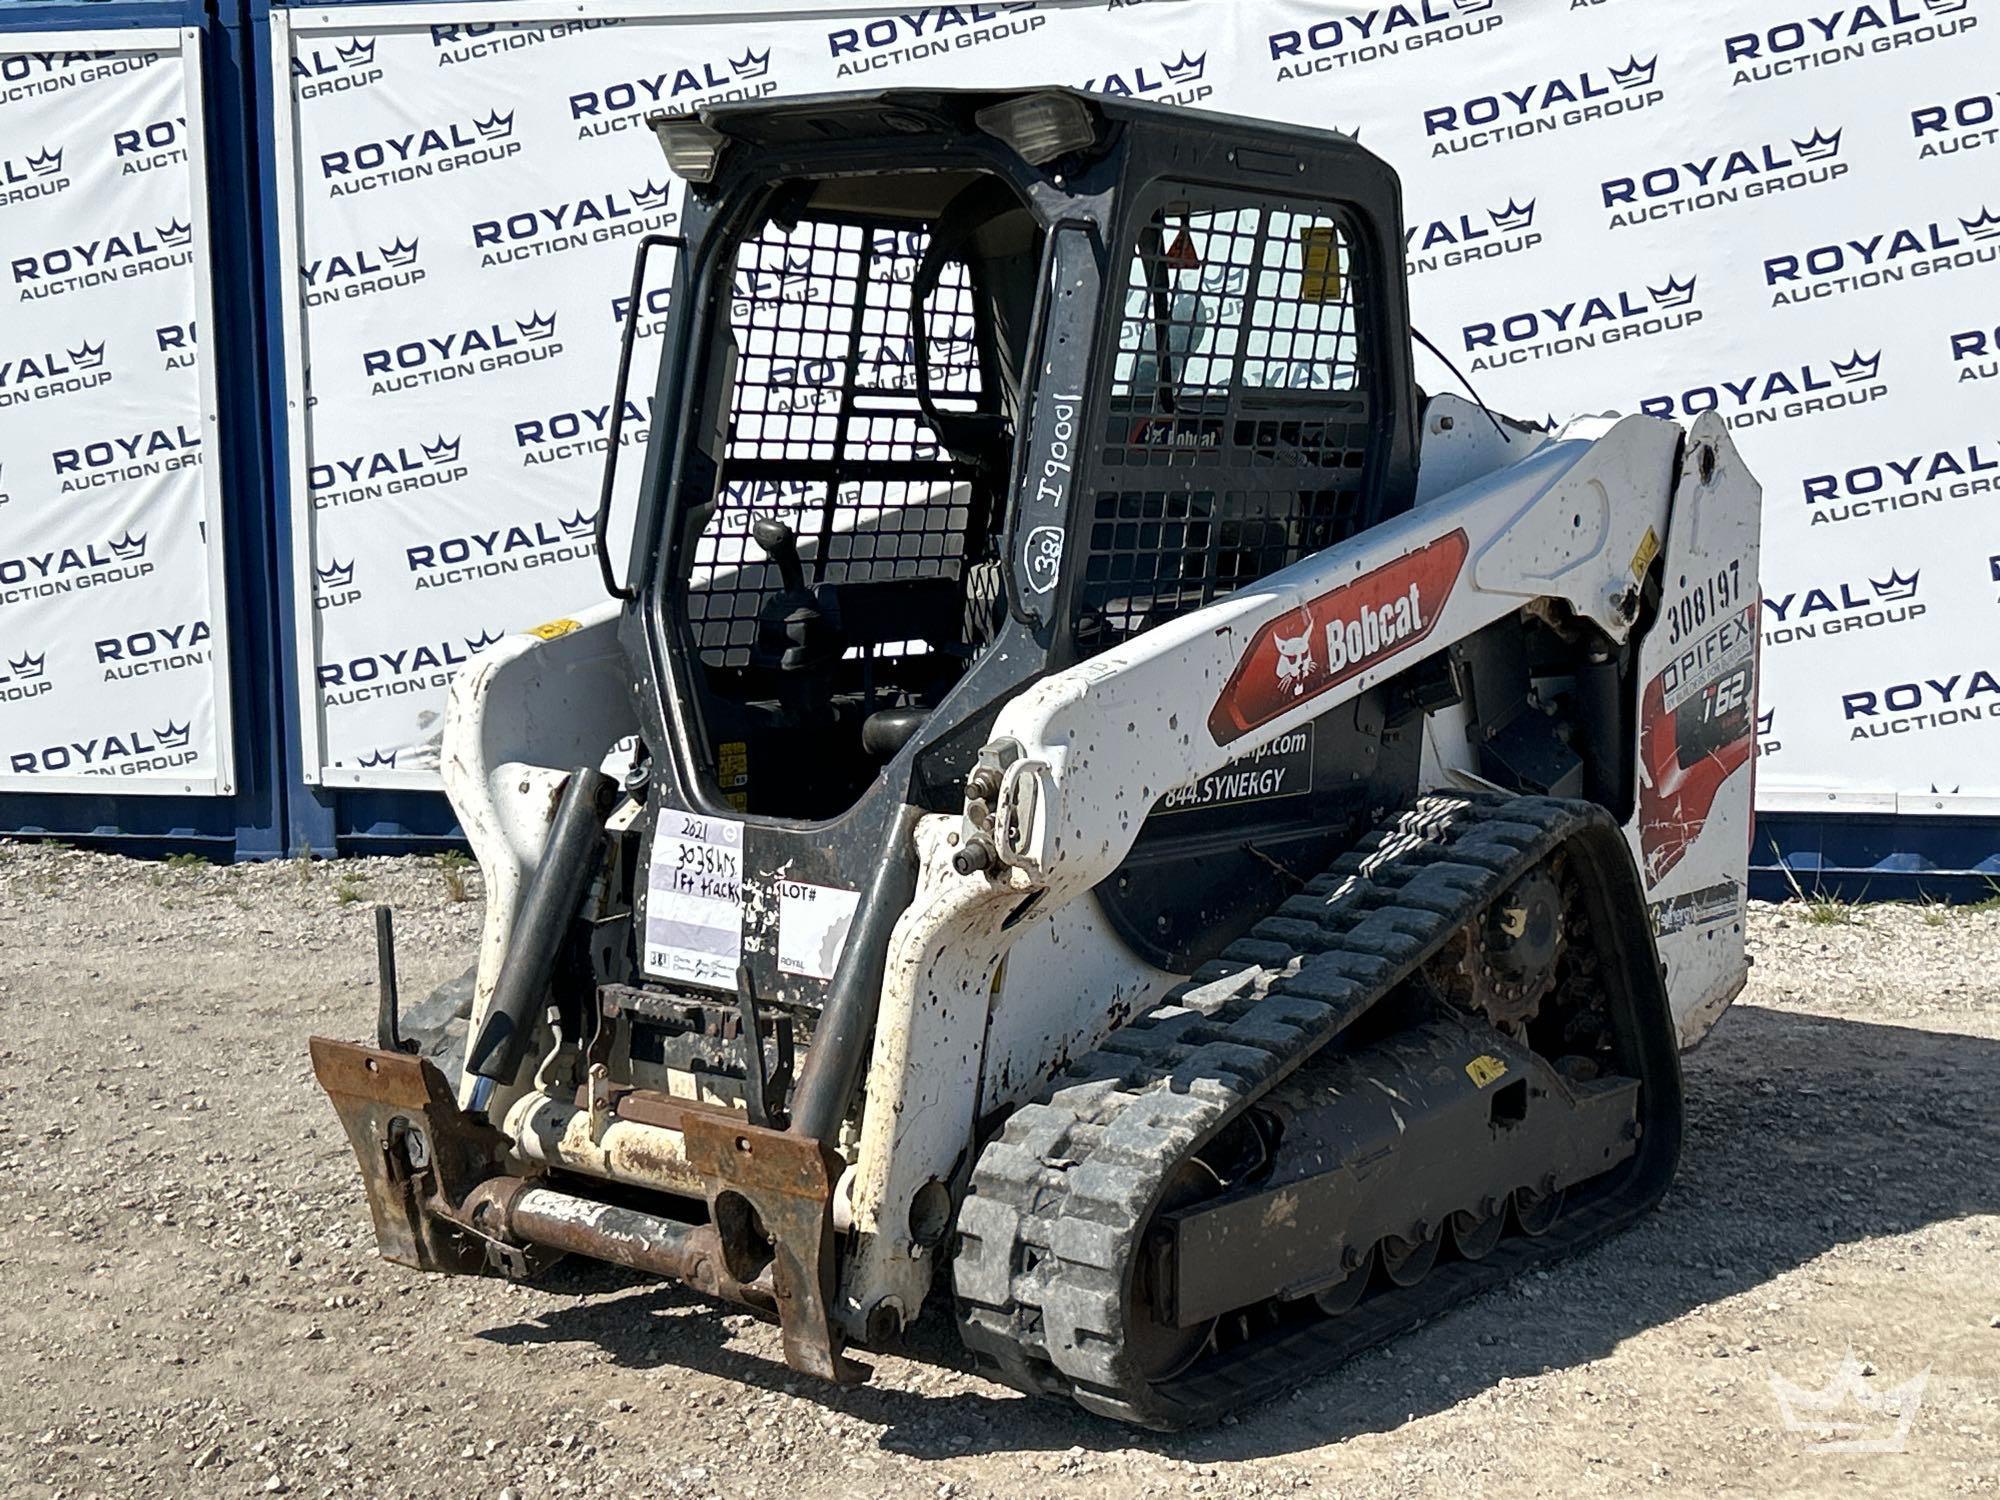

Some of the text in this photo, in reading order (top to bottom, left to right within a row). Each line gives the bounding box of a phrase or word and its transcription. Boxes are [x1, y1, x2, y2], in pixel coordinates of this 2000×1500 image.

[439, 29, 544, 67] AUCTION
[828, 5, 996, 58] ROYAL
[836, 15, 1046, 78] AUCTION GROUP
[1269, 0, 1449, 60] ROYAL
[1277, 15, 1503, 82] AUCTION GROUP
[1725, 0, 1919, 64] ROYAL
[1732, 16, 1977, 86] AUCTION GROUP
[81, 53, 158, 83] GROUP
[301, 69, 383, 99] GROUP
[569, 63, 730, 120] ROYAL
[1424, 72, 1609, 136] ROYAL
[1431, 91, 1664, 158] AUCTION GROUP
[321, 124, 475, 179] ROYAL
[330, 142, 521, 198] AUCTION GROUP
[1601, 144, 1792, 208] ROYAL
[472, 194, 631, 248] ROYAL
[1609, 163, 1848, 230] AUCTION GROUP
[11, 231, 158, 283] ROYAL
[481, 213, 677, 268] AUCTION GROUP
[1444, 233, 1542, 266] GROUP
[1764, 223, 1959, 286] ROYAL
[20, 268, 118, 302] AUCTION
[345, 269, 426, 298] GROUP
[1771, 266, 1903, 308] AUCTION
[1462, 291, 1648, 352] ROYAL
[1470, 310, 1703, 373] AUCTION GROUP
[363, 325, 518, 376] ROYAL
[372, 343, 563, 396] AUCTION GROUP
[35, 372, 112, 399] GROUP
[1640, 366, 1831, 420] ROYAL
[1784, 385, 1887, 418] GROUP
[52, 426, 201, 475] ROYAL
[1803, 445, 1998, 504] ROYAL
[62, 462, 160, 494] AUCTION
[388, 467, 468, 494] GROUP
[1811, 487, 1943, 525] AUCTION
[406, 522, 560, 570] ROYAL
[1034, 531, 1063, 576] 381
[76, 562, 153, 589] GROUP
[415, 559, 518, 590] AUCTION
[1667, 559, 1740, 645] 308197
[1823, 604, 1926, 635] GROUP
[1326, 582, 1422, 675] Bobcat
[1663, 612, 1748, 694] OPIFEX
[104, 652, 203, 682] AUCTION
[316, 642, 466, 689] ROYAL
[325, 678, 425, 708] AUCTION
[1850, 706, 1981, 741] AUCTION
[10, 732, 154, 773] ROYAL
[121, 751, 198, 776] GROUP
[1165, 768, 1286, 807] 844.SYNERGY
[681, 818, 708, 842] 2021
